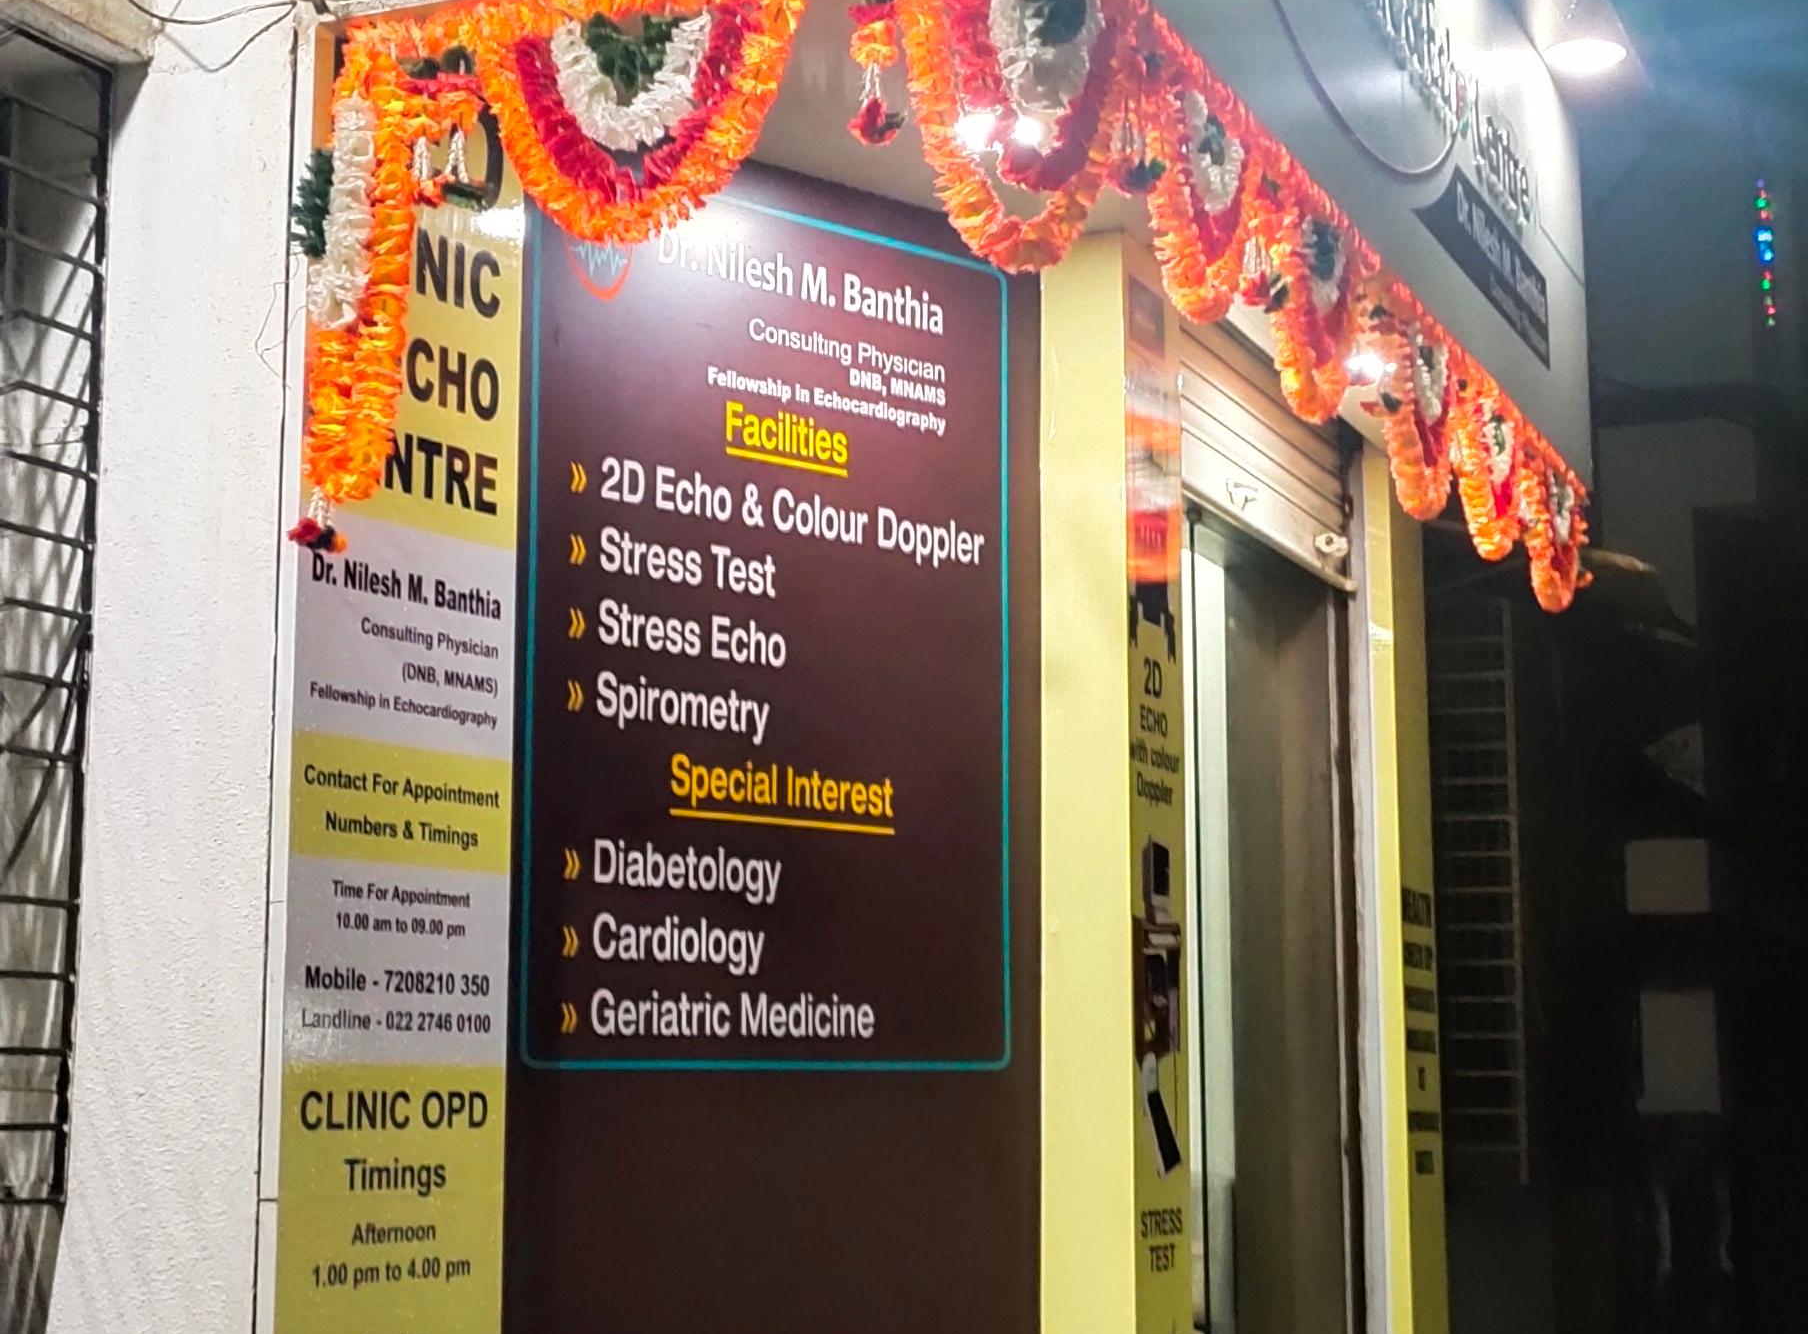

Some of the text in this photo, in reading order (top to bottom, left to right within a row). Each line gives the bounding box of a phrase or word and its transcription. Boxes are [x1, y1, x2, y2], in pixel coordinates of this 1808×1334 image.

[416, 228, 500, 319] NIC
[658, 227, 944, 335] Dr. Nilesh M. Banthia
[749, 318, 945, 383] Consulting Physician
[407, 336, 499, 422] CHO
[707, 366, 946, 435] Fellowship in Echocardiography
[849, 368, 946, 406] DNB, MNAMS
[726, 401, 847, 464] Facilities
[385, 433, 498, 516] NTRE
[601, 456, 984, 567] 2D Echo & Colour Doppler
[600, 526, 776, 597] Stress Test
[312, 552, 501, 620] Dr. Nilesh M. Banthia
[361, 617, 499, 660] Consulting Physician
[599, 598, 786, 668] Stress Echo
[402, 661, 498, 697] (DNB, MNAMS)
[1143, 657, 1162, 699] 2D
[310, 682, 498, 730] Fellowship in Echocardiography
[596, 671, 769, 745] Spirometry
[1140, 705, 1168, 737] ECHO
[304, 764, 499, 809] Contact For Appointment
[670, 753, 893, 818] Special Interest
[1137, 771, 1173, 807] Doppler
[325, 811, 478, 849] Numbers & Timings
[594, 838, 781, 904] Diabetology
[332, 880, 470, 910] Time For Appointment
[336, 911, 465, 939] 10.00 am to 09.00 pm
[593, 912, 765, 975] Cardiology
[305, 965, 367, 993] Mobile
[384, 970, 456, 996] 7208210
[460, 973, 490, 997] 350
[301, 1009, 371, 1031] Landline
[385, 1010, 414, 1031] 022
[417, 1012, 453, 1033] 2746
[456, 1013, 491, 1034] 0100
[591, 988, 875, 1038] Geriatric Medicine
[300, 1090, 488, 1131] CLINIC OPD
[345, 1158, 447, 1197] Timings
[351, 1222, 436, 1246] Afternoon
[1140, 1207, 1182, 1240] STRESS
[313, 1256, 470, 1289] 1.00 pm to 4.00 pm
[1149, 1243, 1176, 1273] TEST
